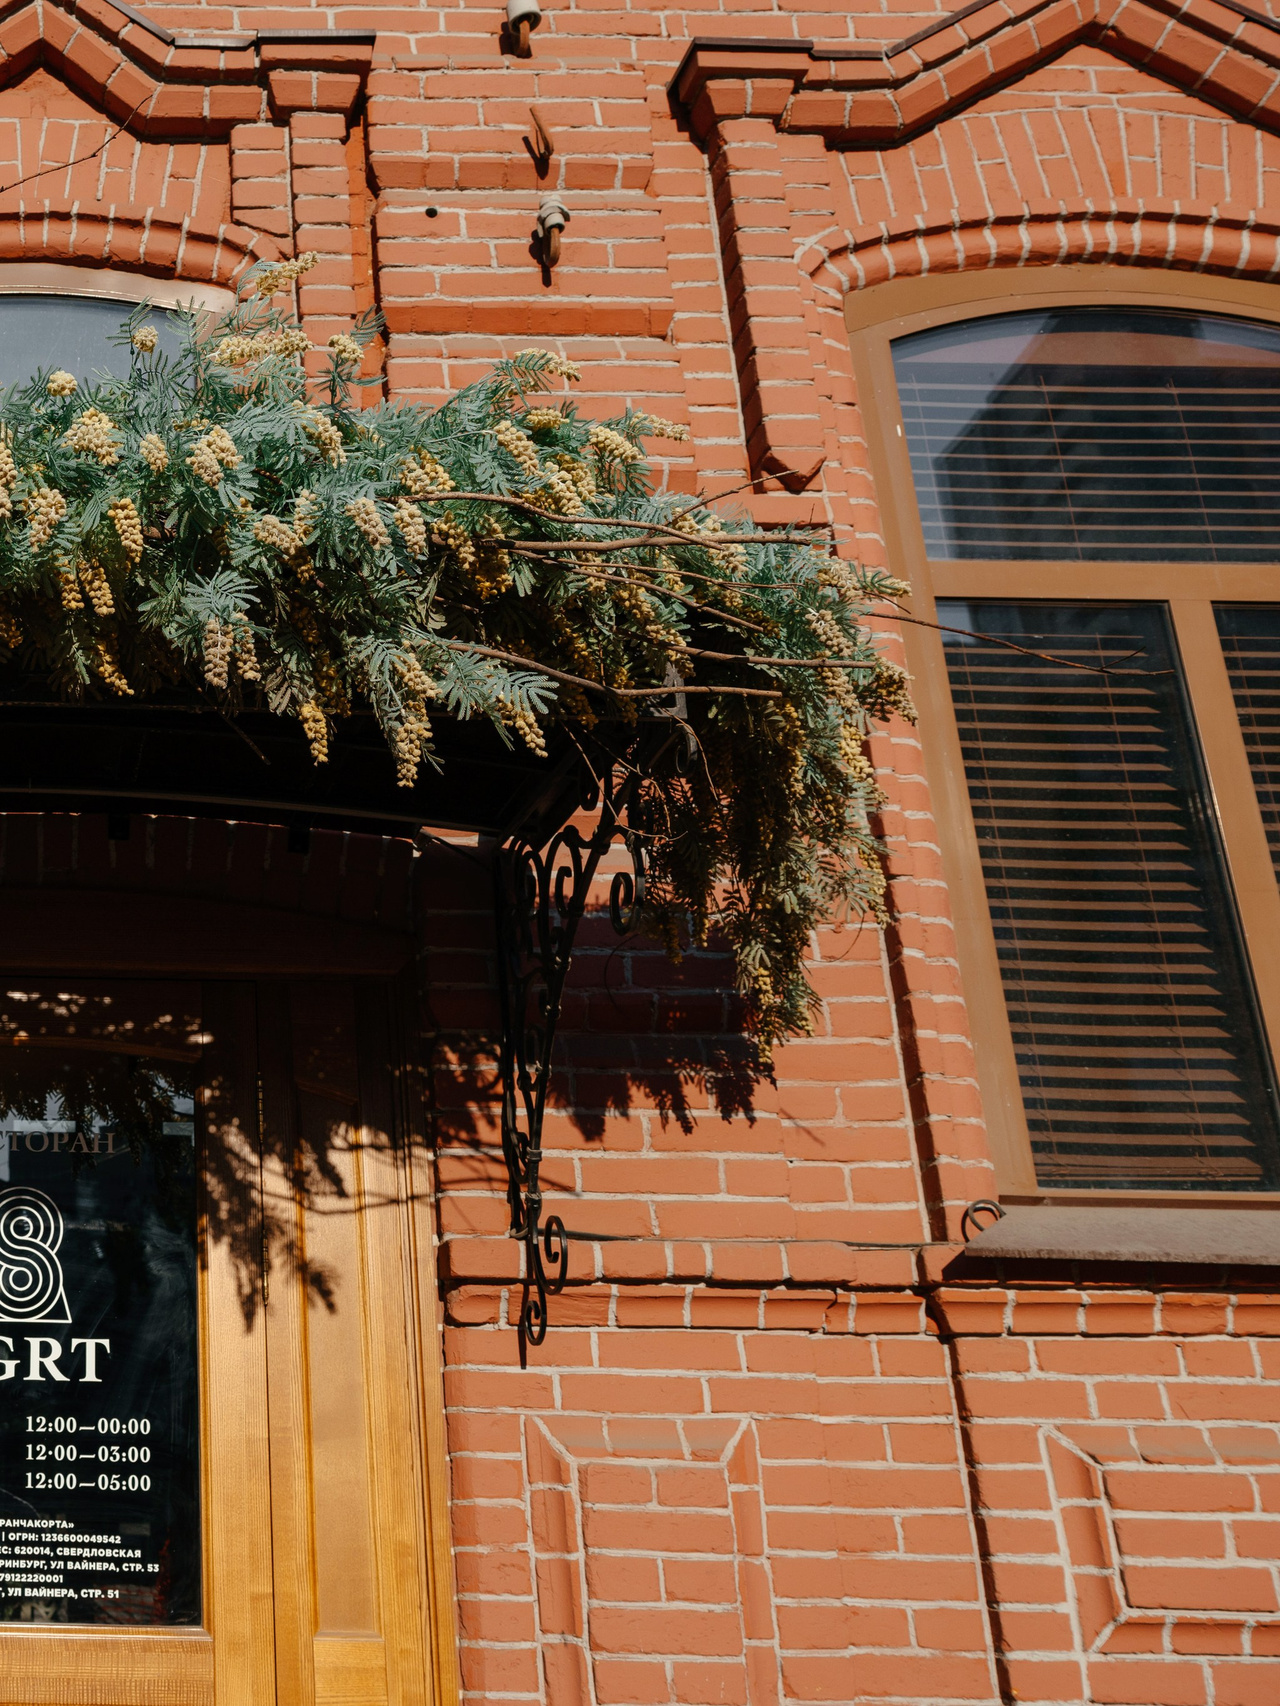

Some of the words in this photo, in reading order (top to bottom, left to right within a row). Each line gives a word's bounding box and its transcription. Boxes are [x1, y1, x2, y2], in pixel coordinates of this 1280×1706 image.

[7, 1532, 39, 1542] ОГРН:
[40, 1533, 122, 1544] 1236600049542
[13, 1545, 54, 1558] 620014,
[55, 1546, 142, 1559] СВЕРДЛОВСКАЯ
[49, 1560, 65, 1570] УЛ
[66, 1559, 120, 1573] ВАЙНЕРА,
[121, 1562, 145, 1573] СТР.
[146, 1563, 160, 1573] 53
[7, 1587, 22, 1597] УЛ
[24, 1586, 79, 1600] ВАЙНЕРА,
[80, 1588, 105, 1599] СТР.
[107, 1589, 120, 1599] 51
